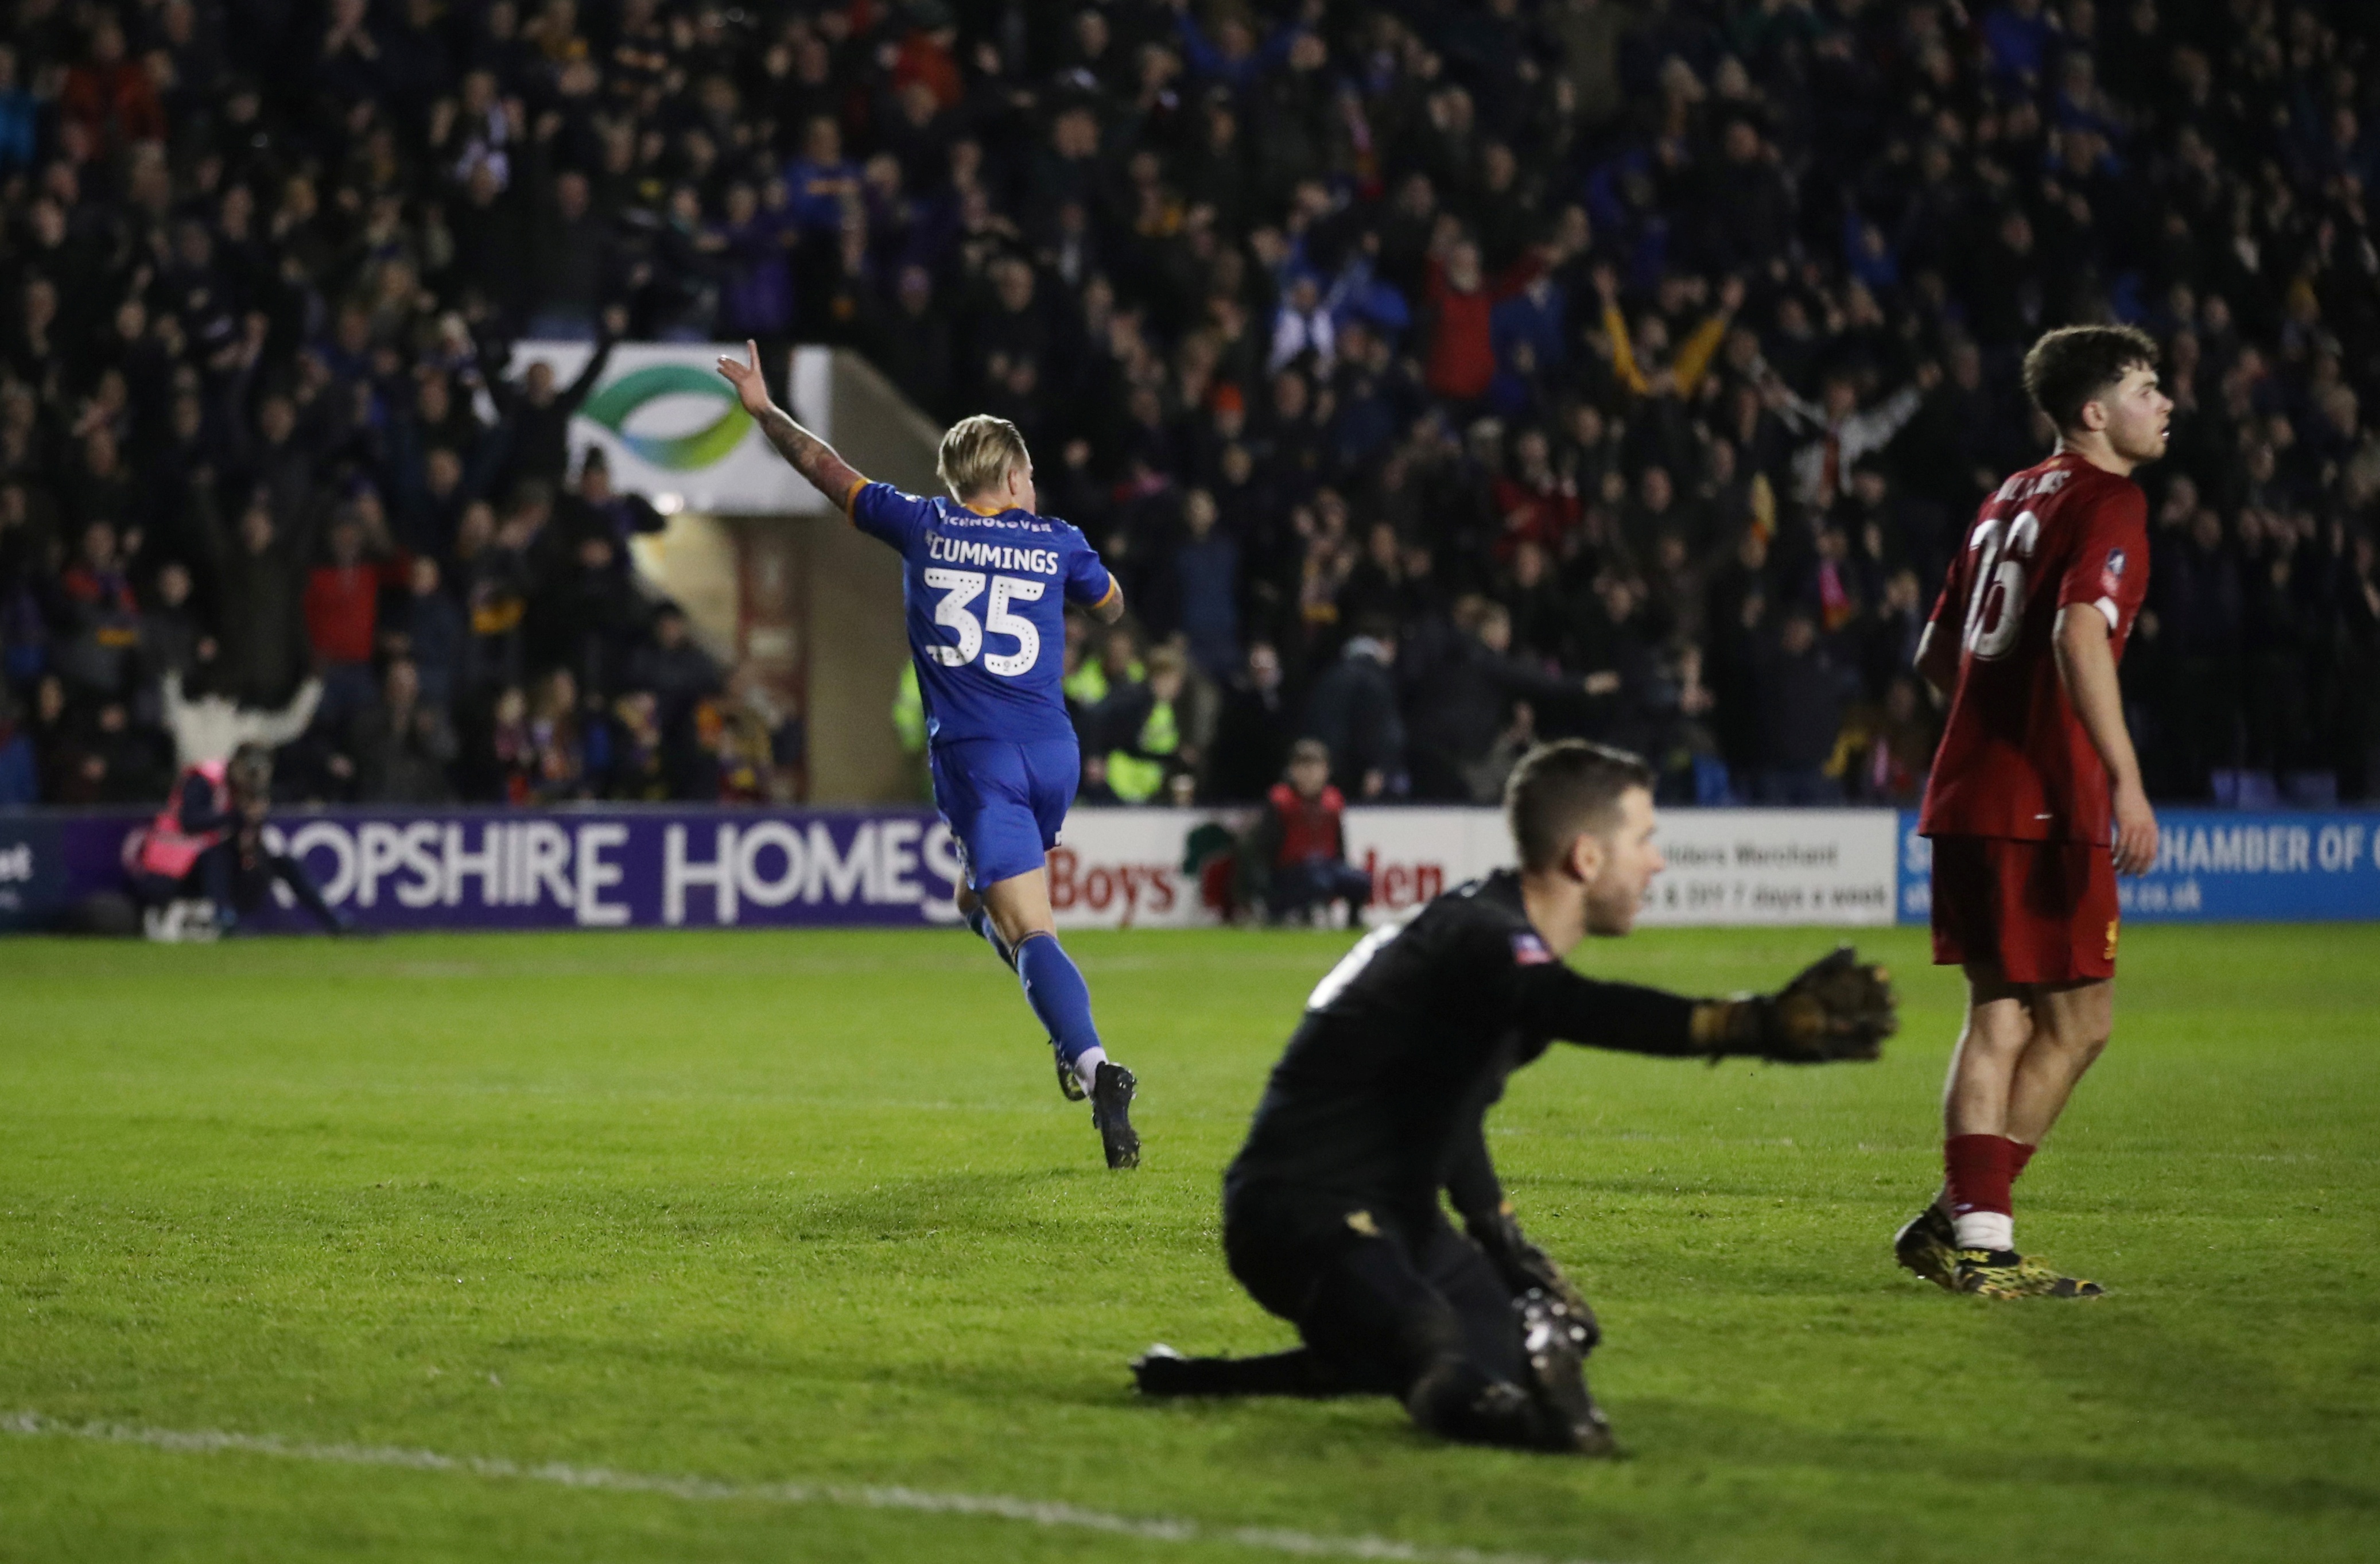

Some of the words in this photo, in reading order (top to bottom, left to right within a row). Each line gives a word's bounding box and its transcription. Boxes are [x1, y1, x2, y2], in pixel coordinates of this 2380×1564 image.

[929, 536, 1059, 575] CUMMINGS
[924, 567, 1045, 677] 35
[123, 821, 631, 926] OPSHIRE
[662, 820, 961, 925] HOMES
[1048, 848, 1175, 927] Boys
[2149, 824, 2312, 873] HAMBER
[2317, 824, 2366, 872] OF
